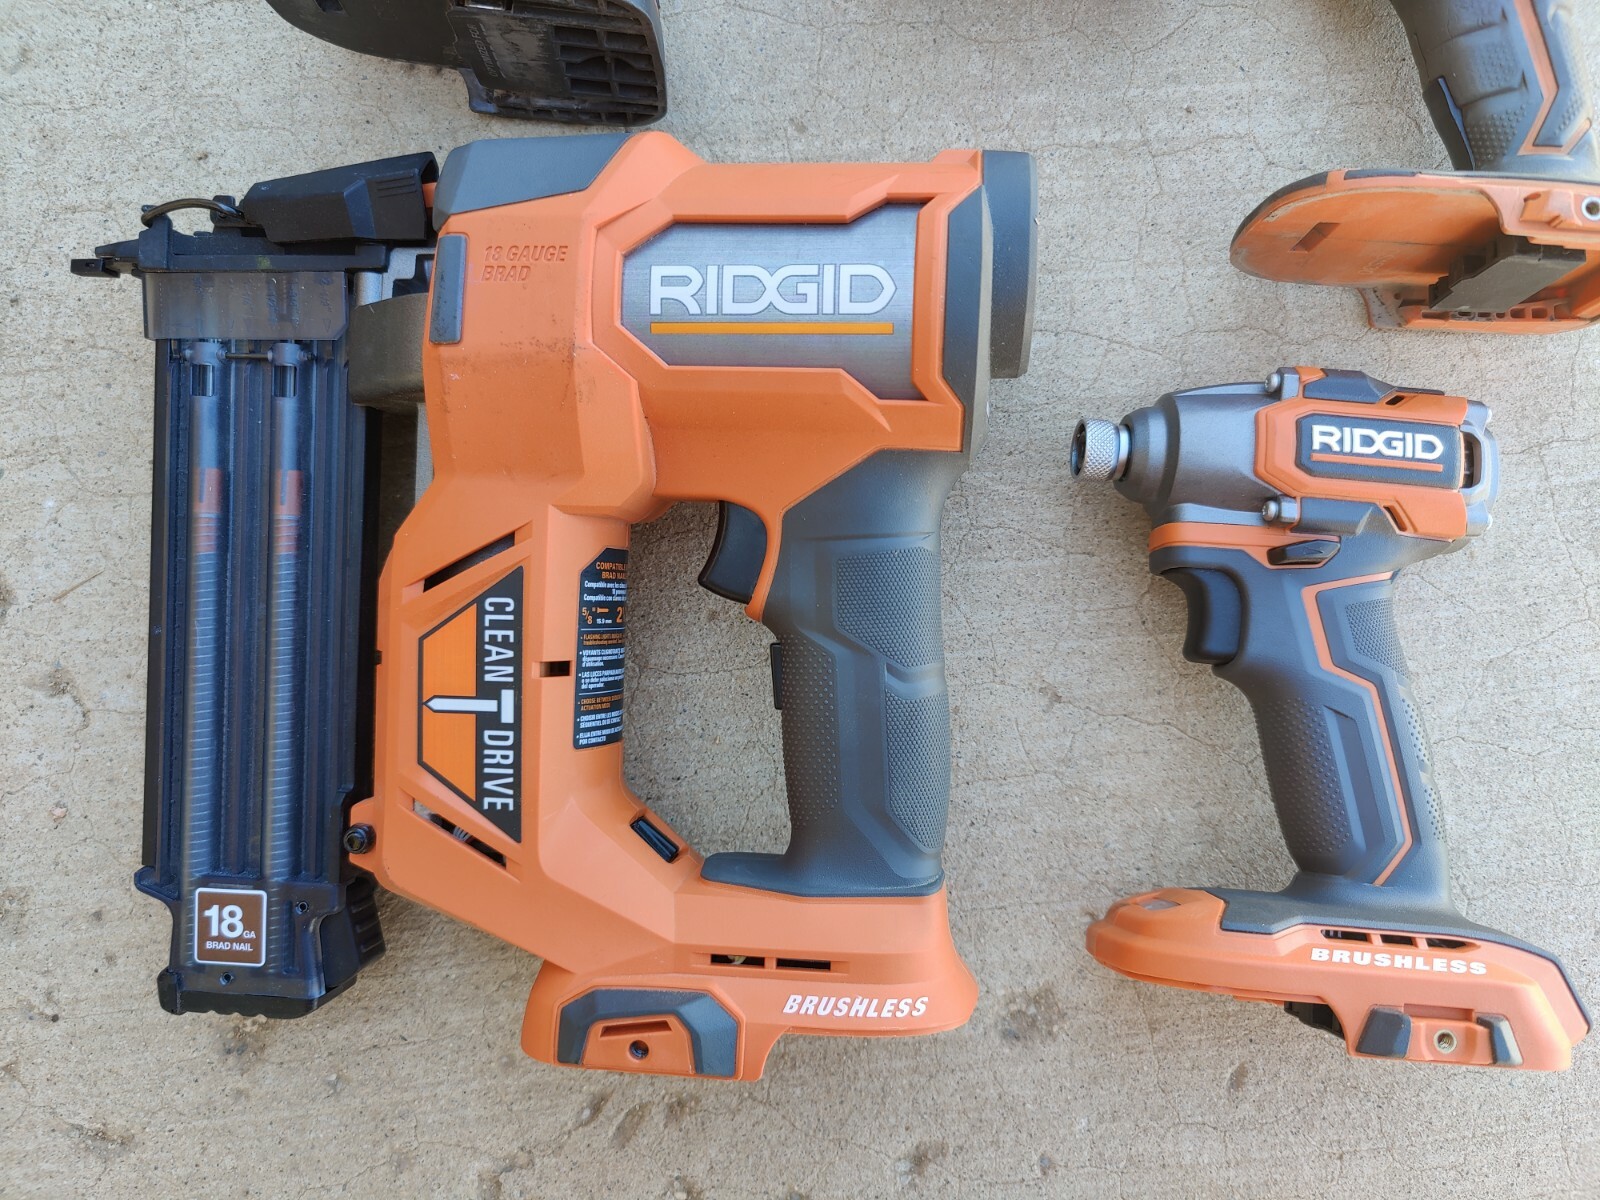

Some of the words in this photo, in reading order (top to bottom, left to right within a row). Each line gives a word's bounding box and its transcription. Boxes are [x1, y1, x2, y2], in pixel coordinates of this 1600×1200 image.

[484, 245, 505, 262] 18
[506, 245, 569, 264] GAUGE
[481, 265, 531, 282] BRAD
[649, 263, 898, 316] RIDGID
[1311, 424, 1444, 460] RIDGID
[483, 596, 515, 683] CLEAN
[482, 729, 515, 812] DRIVE
[203, 904, 244, 939] 18
[243, 930, 256, 939] GA
[205, 940, 231, 951] BRAD
[232, 941, 253, 952] NAIL
[1310, 947, 1488, 976] BRUSHLESS
[782, 994, 930, 1019] BRUSHLESS
